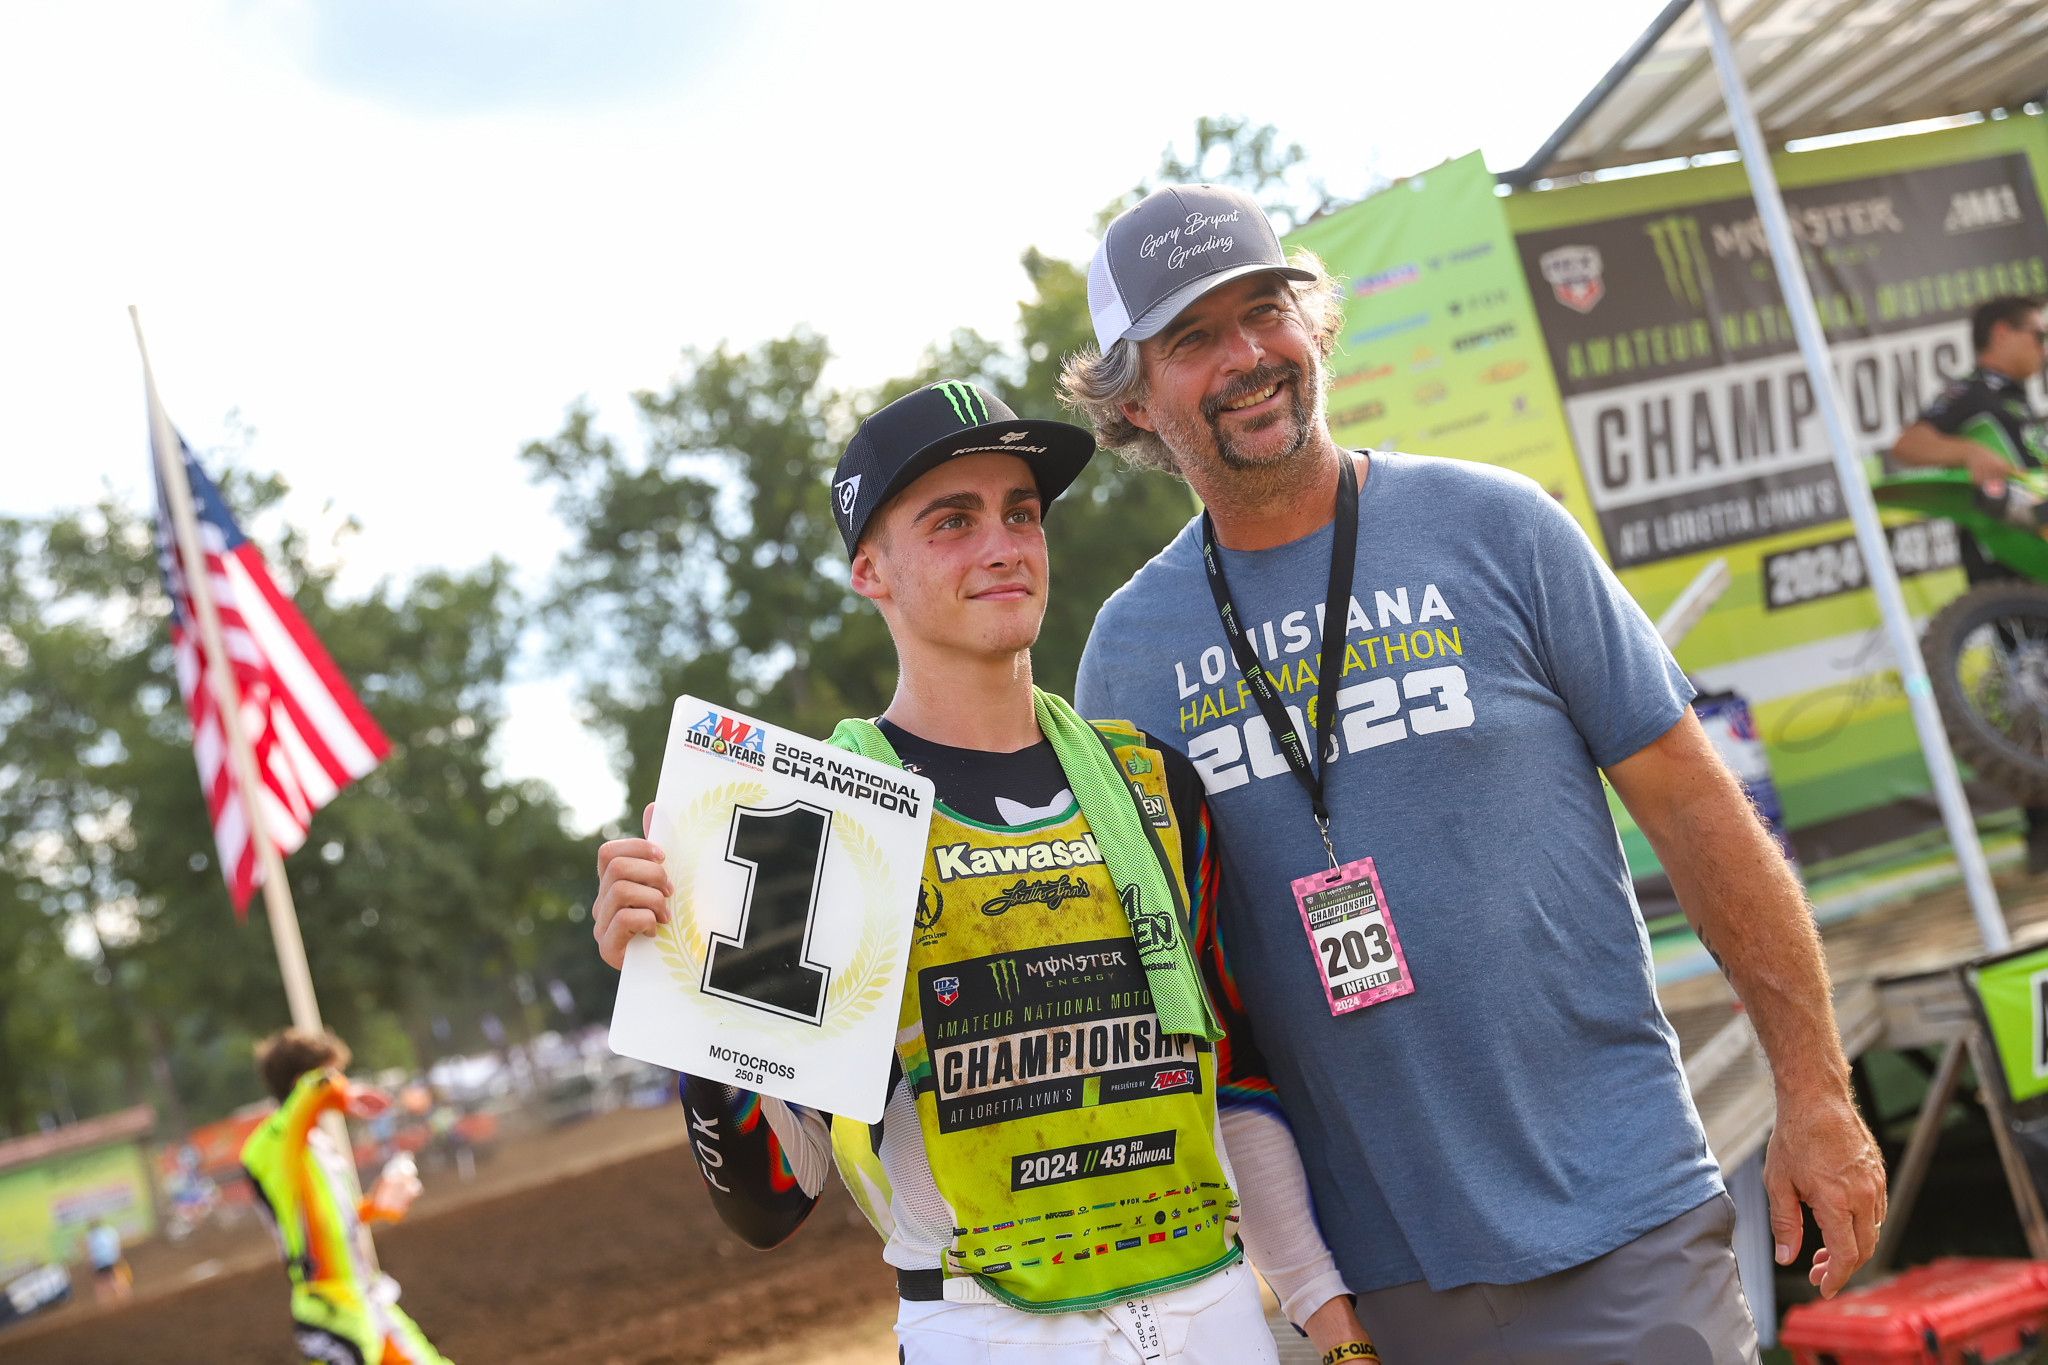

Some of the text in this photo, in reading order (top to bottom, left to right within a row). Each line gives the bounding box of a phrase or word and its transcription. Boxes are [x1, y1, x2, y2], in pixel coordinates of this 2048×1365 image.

[1140, 210, 1241, 258] Gary Bryant
[1168, 235, 1234, 270] Grading
[1566, 316, 1711, 380] AMATEUR
[1721, 293, 1865, 352] NATINAL
[1876, 256, 2047, 322] MOTOCROSS
[952, 445, 1048, 456] Kawasaki
[1619, 522, 1650, 560] AT
[1652, 498, 1754, 552] LORETTA
[1767, 536, 1863, 604] 2024
[1180, 678, 1252, 734] HALF
[685, 729, 766, 767] 100 YEARS
[688, 711, 766, 754] AMA
[1187, 665, 1476, 796] 2023
[772, 756, 919, 818] CHAMPION
[775, 742, 921, 801] 2024 NATIONAL
[700, 799, 833, 1028] 1
[1311, 895, 1374, 923] CHAMPIONSHIP
[1026, 951, 1127, 978] MONSTER
[1320, 923, 1393, 979] 203
[1046, 972, 1115, 988] ENERGY
[1341, 971, 1390, 997] INFIELD
[937, 989, 1150, 1040] AMATEUR NATIONAL MOTO
[1335, 996, 1360, 1012] 2024
[708, 1044, 796, 1081] MOTOCROSS
[734, 1068, 764, 1085] 250 B
[1111, 1081, 1138, 1091] PRESENTED
[950, 1088, 1073, 1124] AT LORETTA LYNN'S
[1020, 1151, 1078, 1184] 2024
[1100, 1143, 1127, 1169] 43
[1128, 1147, 1172, 1167] ANNUAL
[1130, 1140, 1143, 1152] RD
[1127, 1197, 1140, 1206] FOX
[1334, 1342, 1378, 1360] OTO-X
